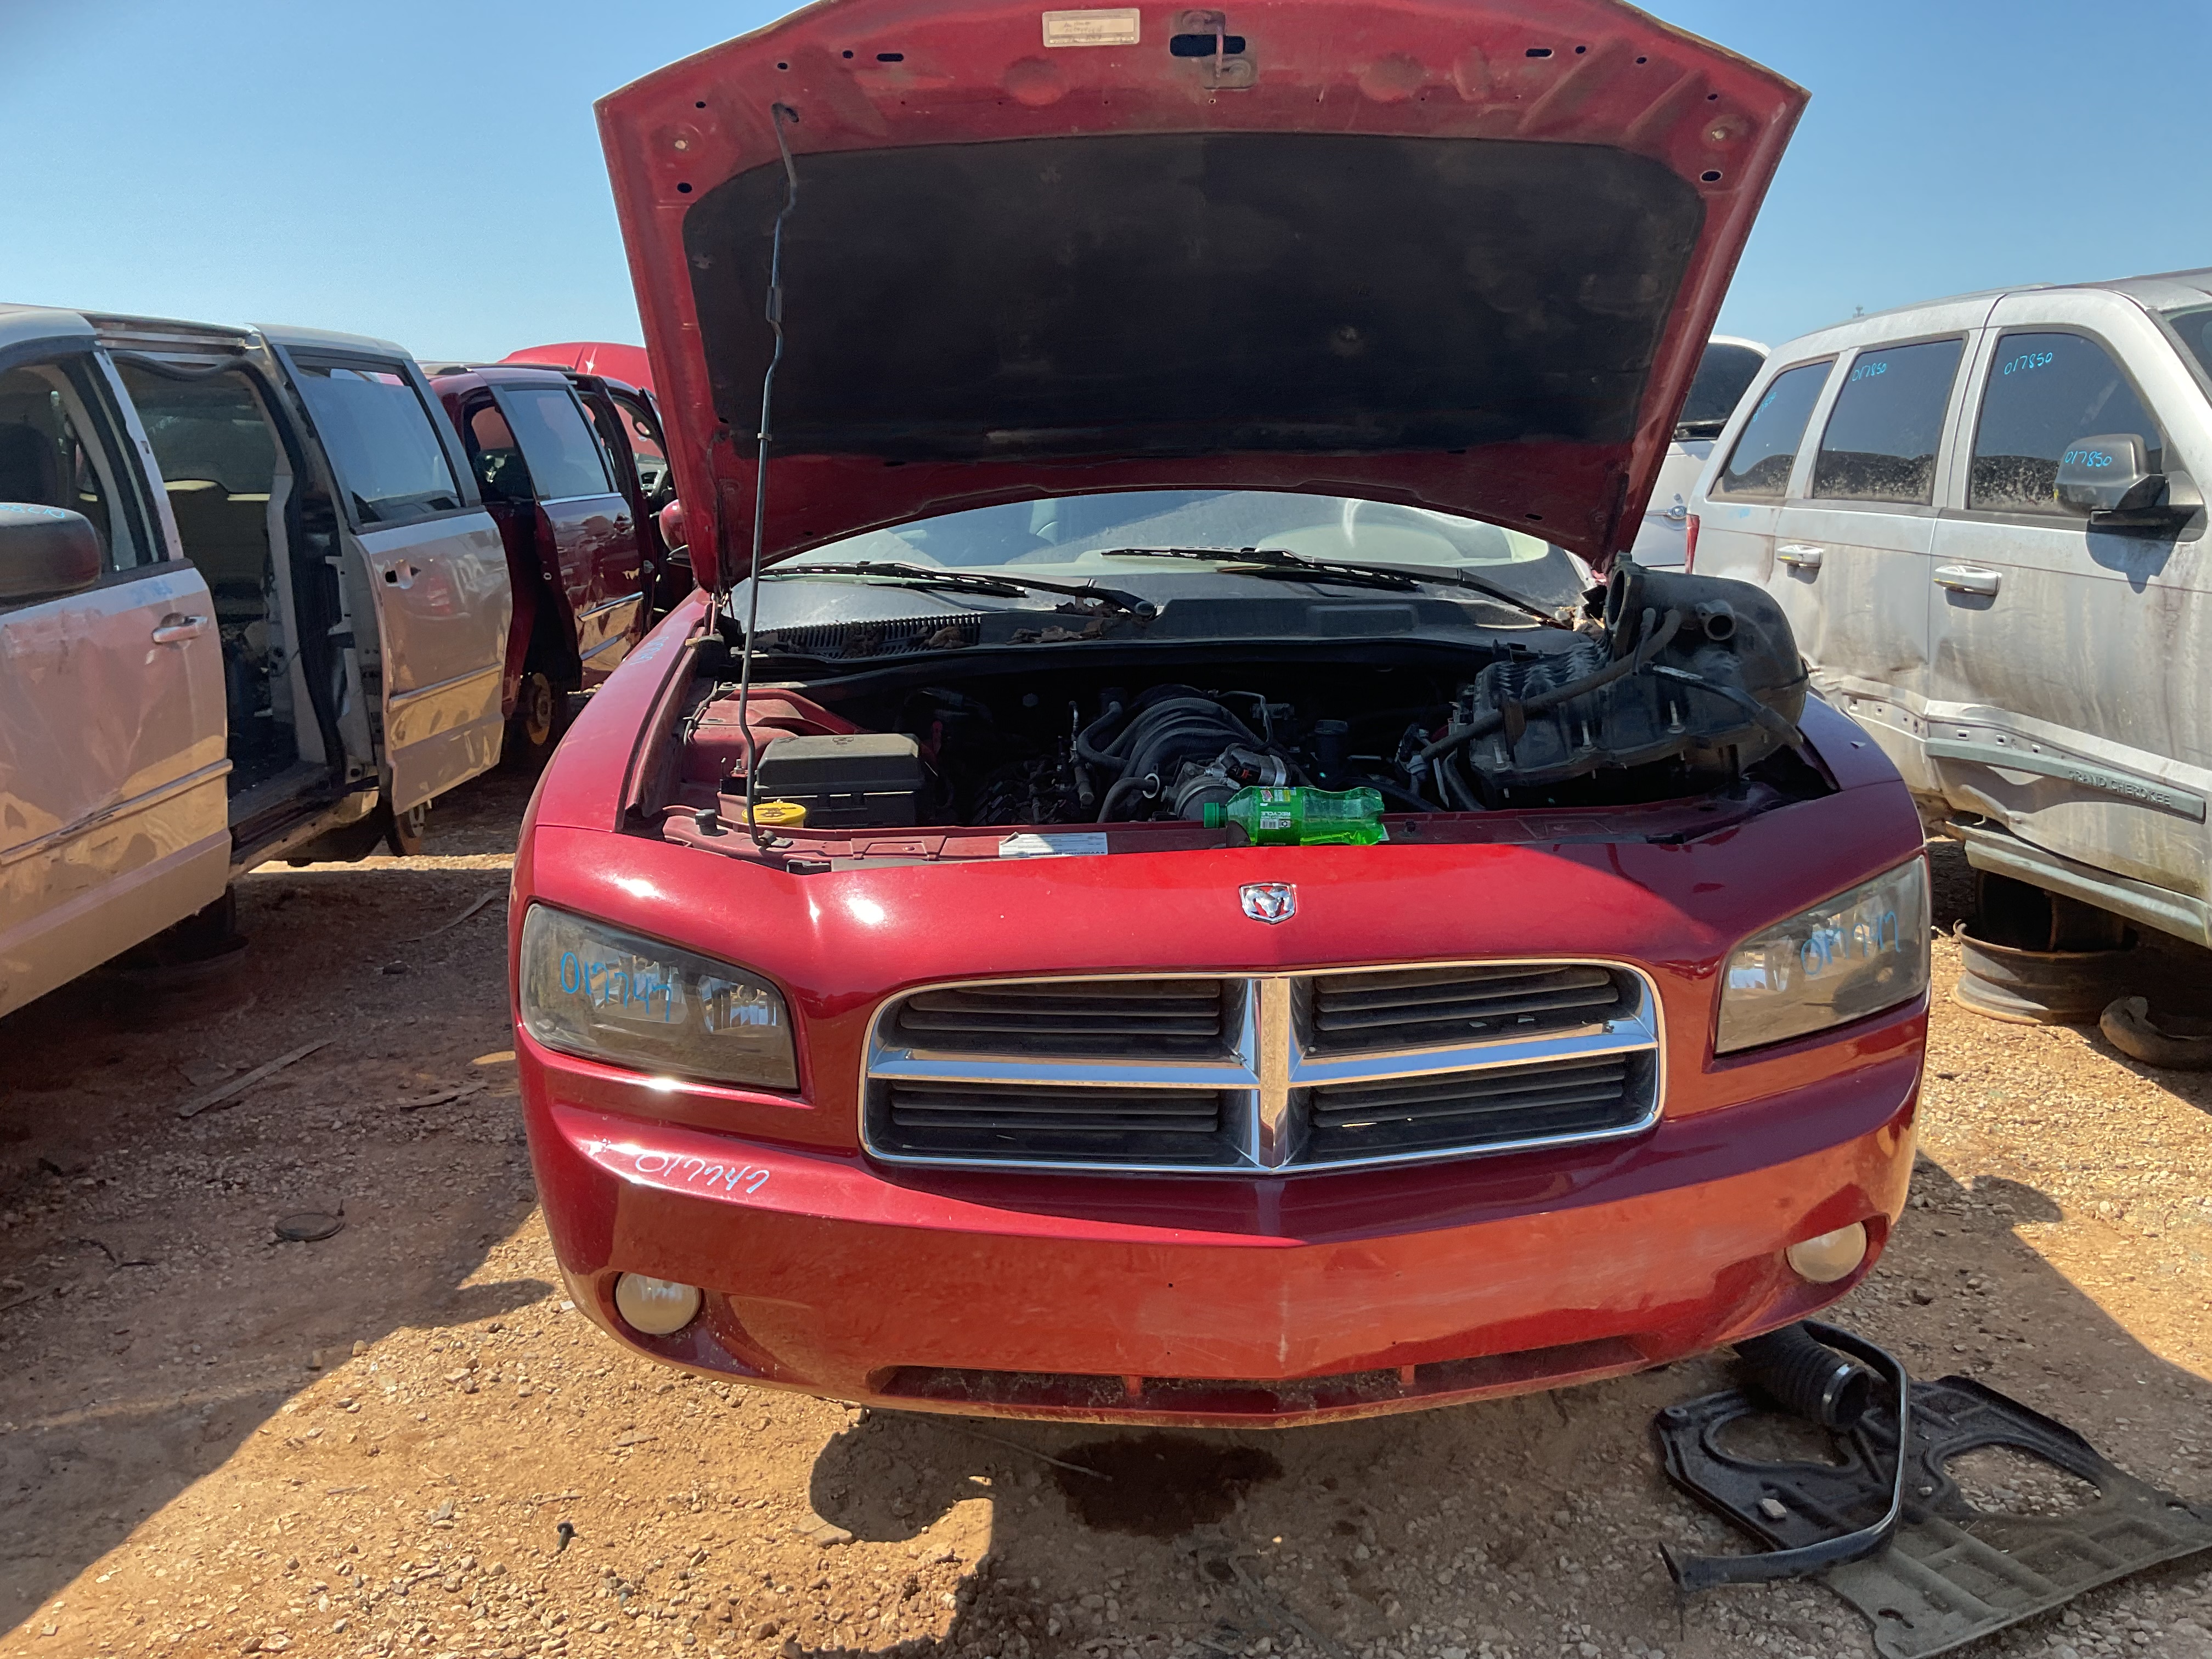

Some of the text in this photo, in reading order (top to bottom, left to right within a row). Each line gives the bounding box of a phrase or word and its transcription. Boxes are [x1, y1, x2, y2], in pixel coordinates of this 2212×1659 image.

[1852, 362, 1888, 382] 017850
[2004, 352, 2053, 375] 017850
[2064, 450, 2112, 467] 017850
[2068, 770, 2171, 806] GRAND CHEROKEE
[560, 951, 672, 1023] 017747
[635, 1153, 770, 1194] 017747
